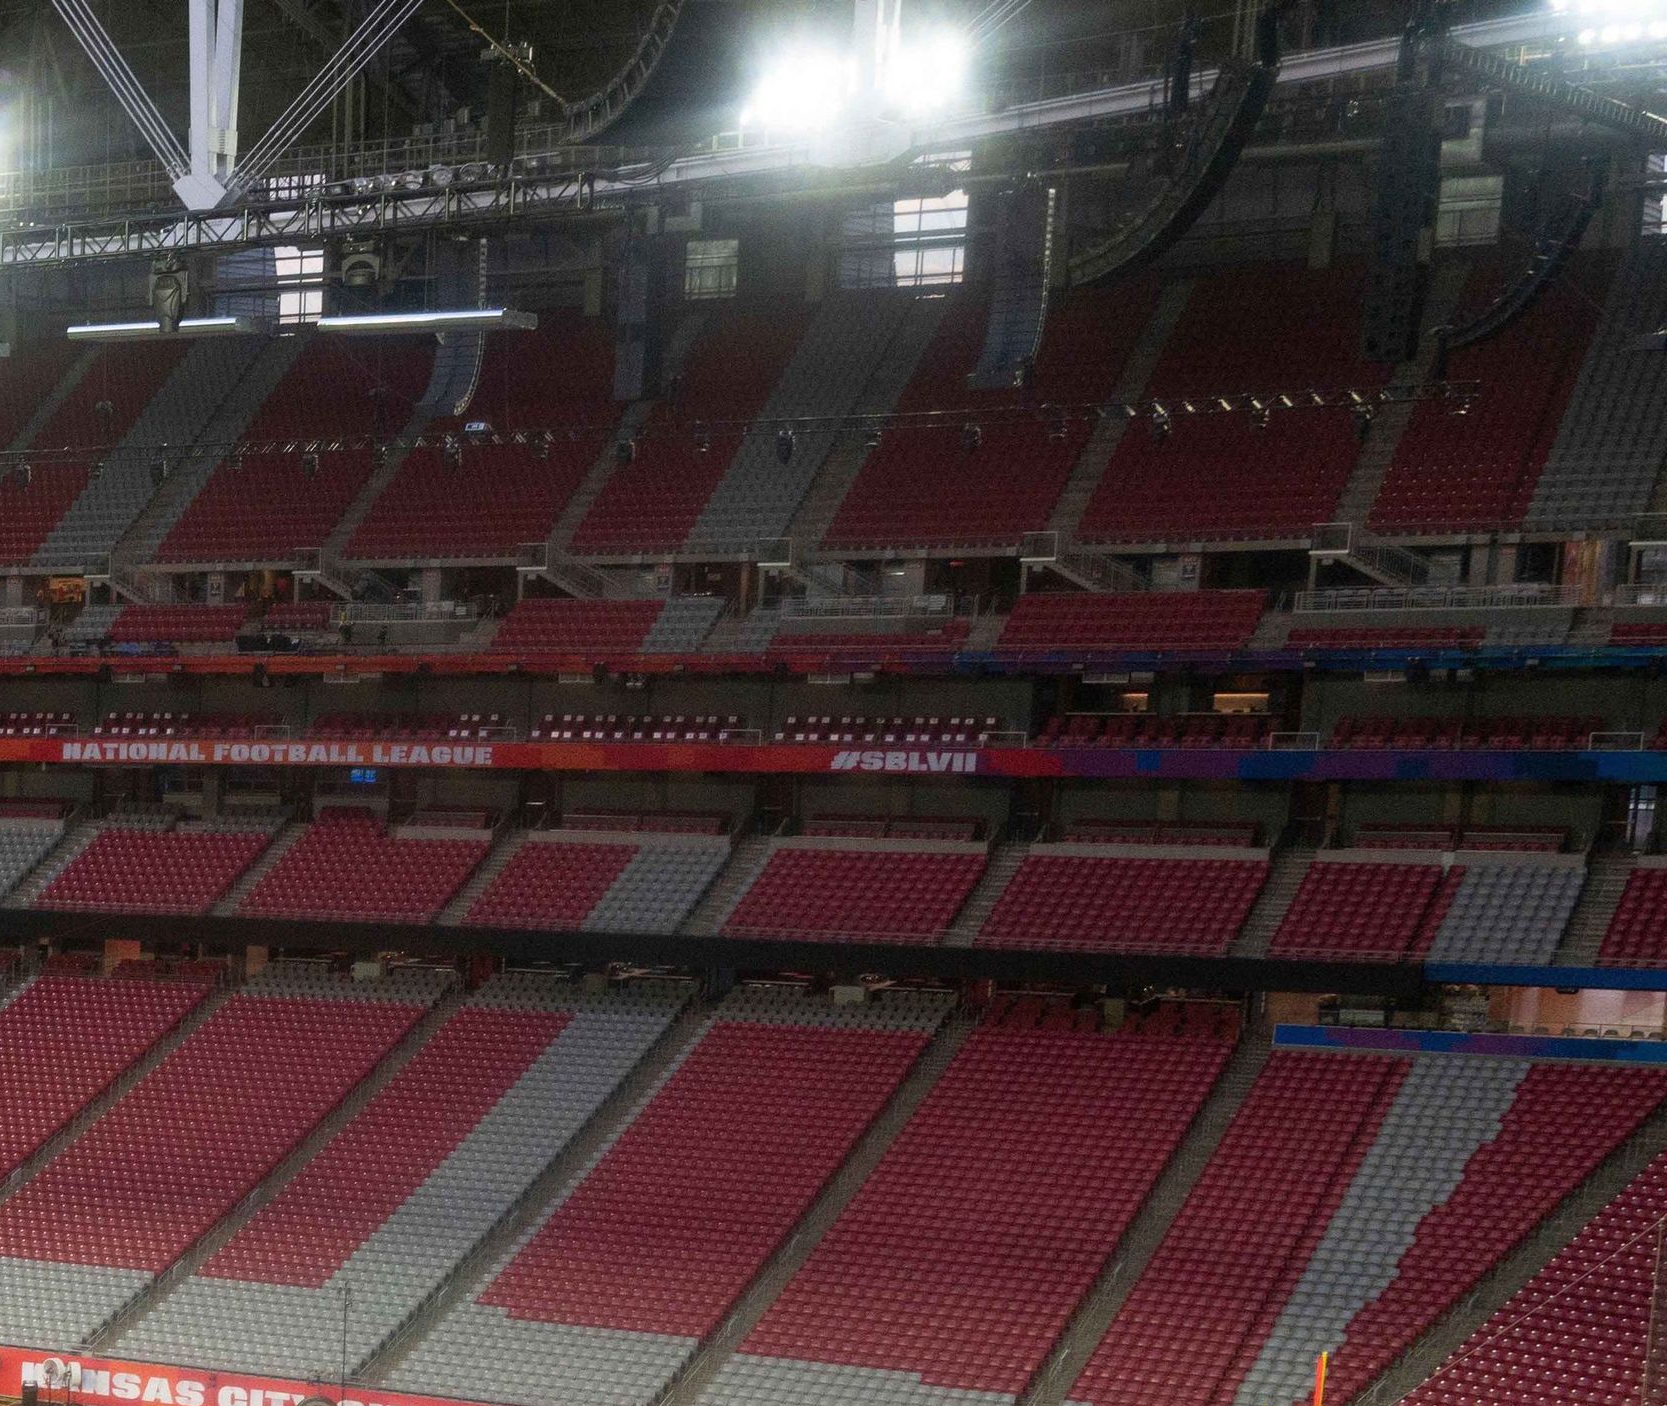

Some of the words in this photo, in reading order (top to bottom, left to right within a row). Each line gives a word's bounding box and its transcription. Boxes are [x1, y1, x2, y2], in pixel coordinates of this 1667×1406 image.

[63, 742, 205, 762] NATIONAL
[213, 744, 364, 764] FOOTBALL
[372, 746, 493, 766] LEAGUE
[830, 751, 977, 772] #SBLVII
